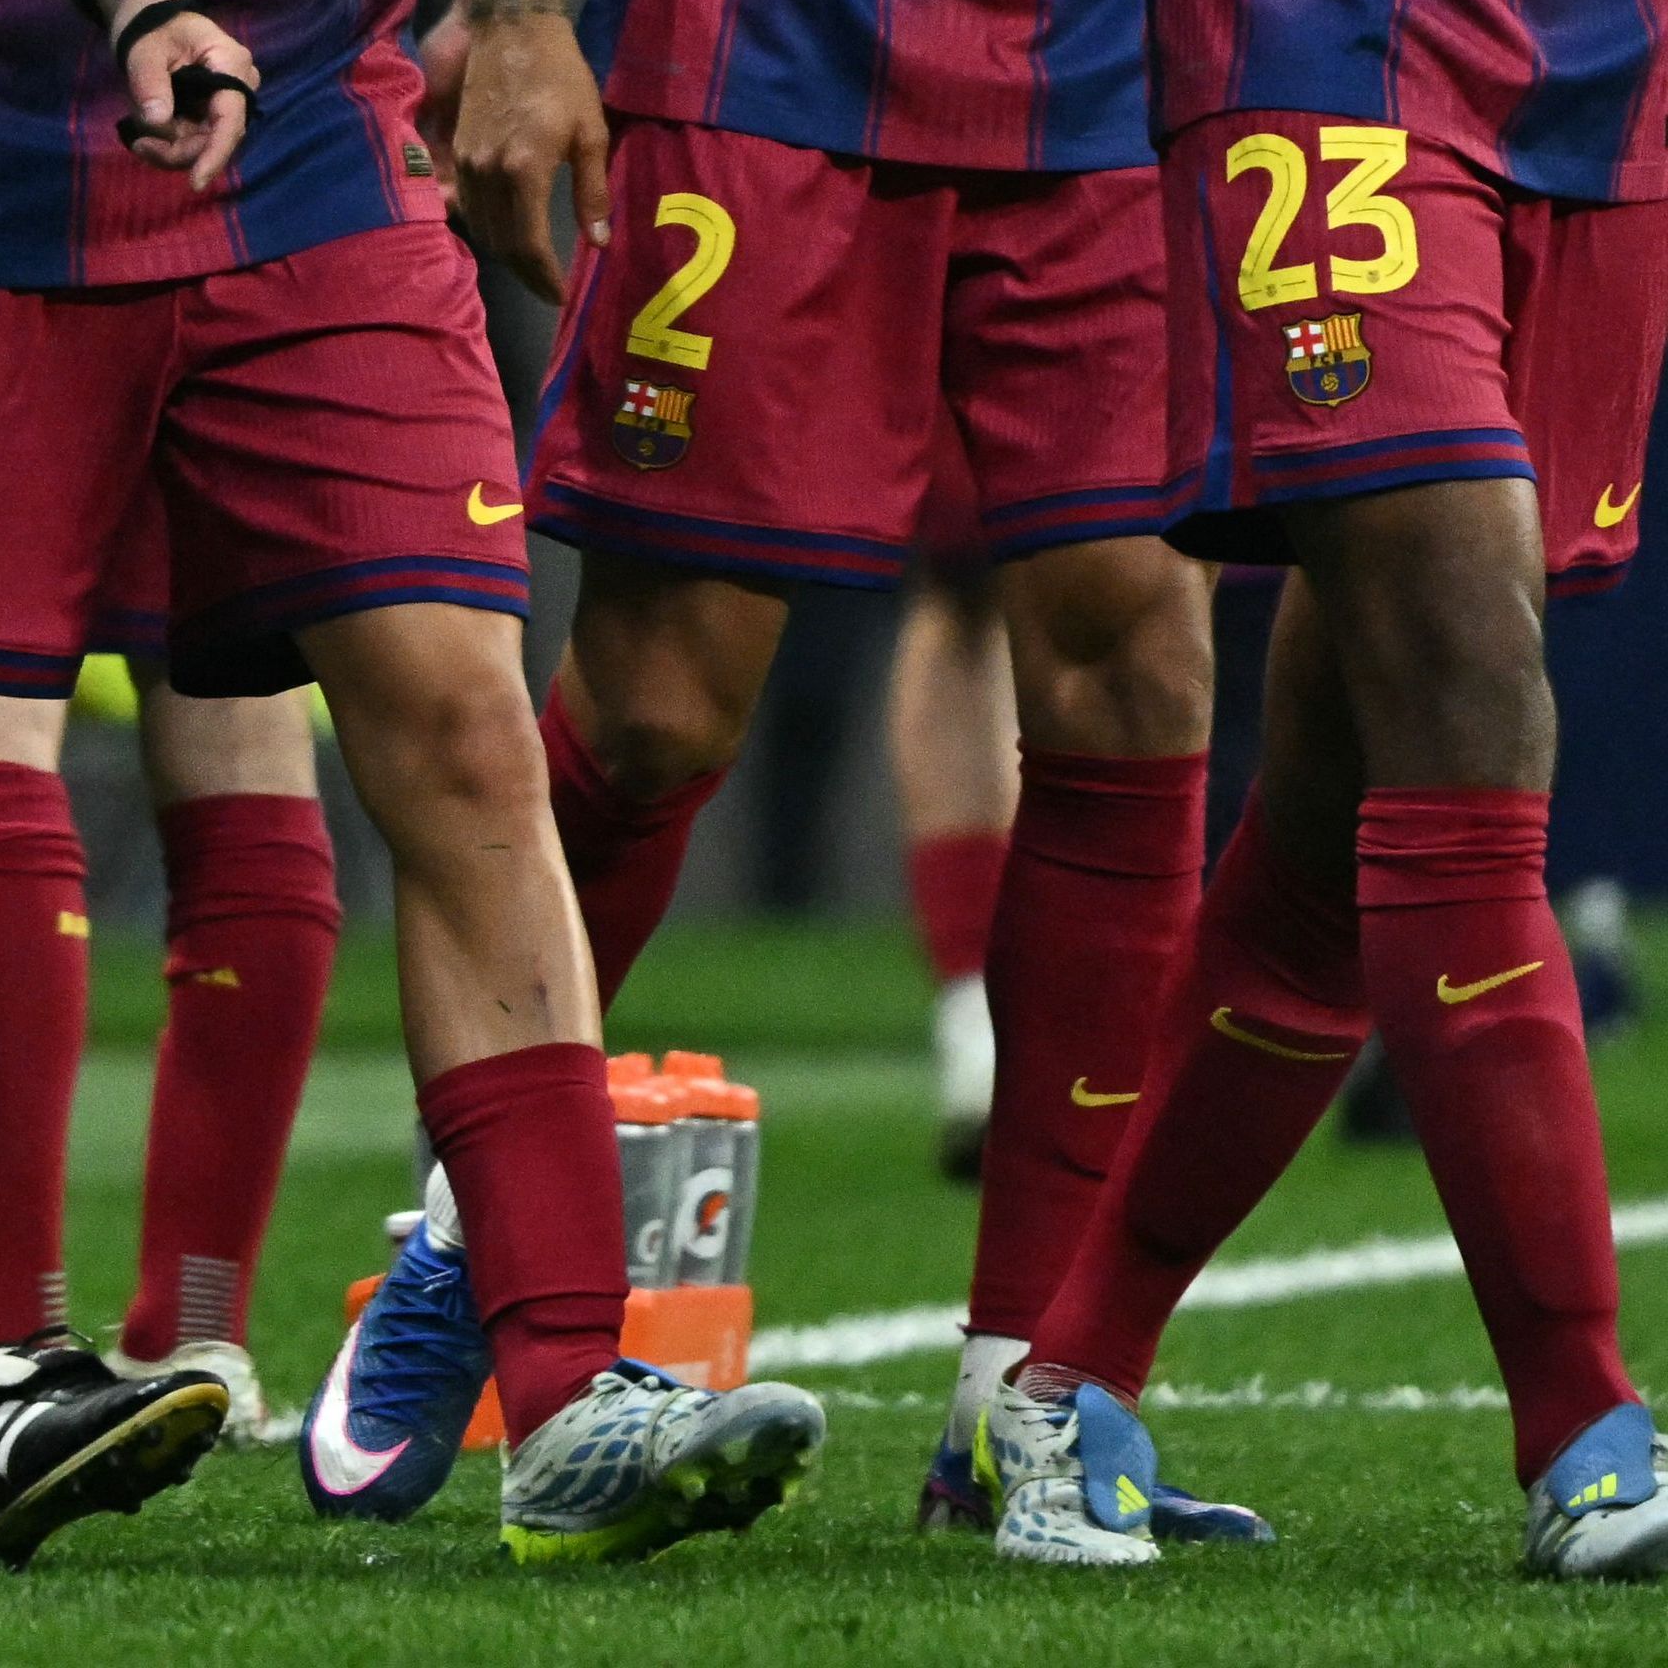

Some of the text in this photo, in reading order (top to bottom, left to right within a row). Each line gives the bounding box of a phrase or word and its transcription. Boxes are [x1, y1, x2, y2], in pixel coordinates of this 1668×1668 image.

[626, 192, 737, 371] 2
[1226, 126, 1420, 311] 23
[673, 1167, 733, 1259] G
